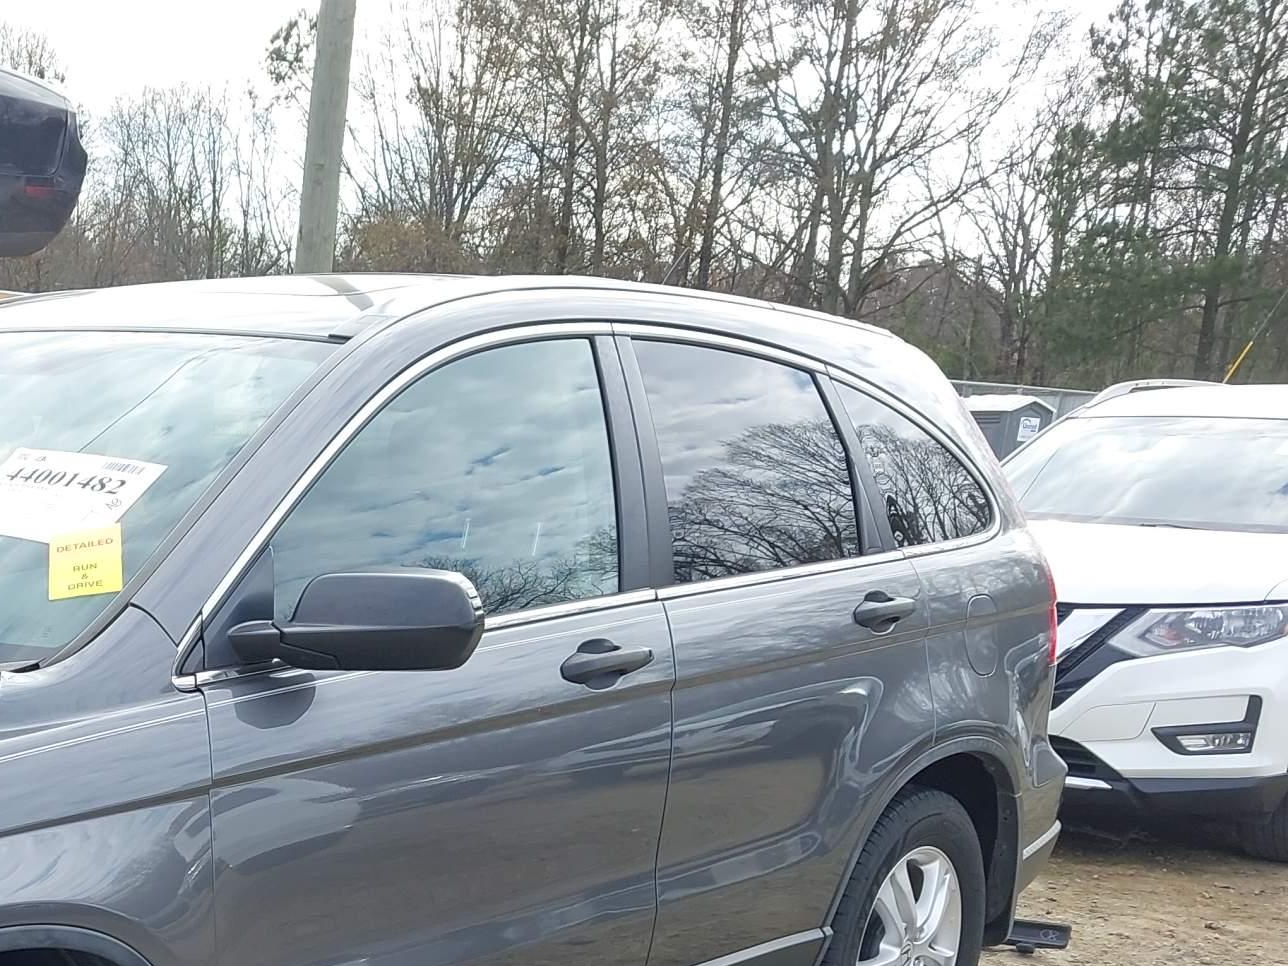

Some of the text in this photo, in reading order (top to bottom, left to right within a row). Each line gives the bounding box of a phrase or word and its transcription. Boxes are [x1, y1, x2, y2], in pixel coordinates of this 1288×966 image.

[6, 467, 127, 495] 44001482
[56, 538, 113, 553] DETAILED
[73, 563, 97, 572] RUN
[67, 580, 103, 591] DRIVE
